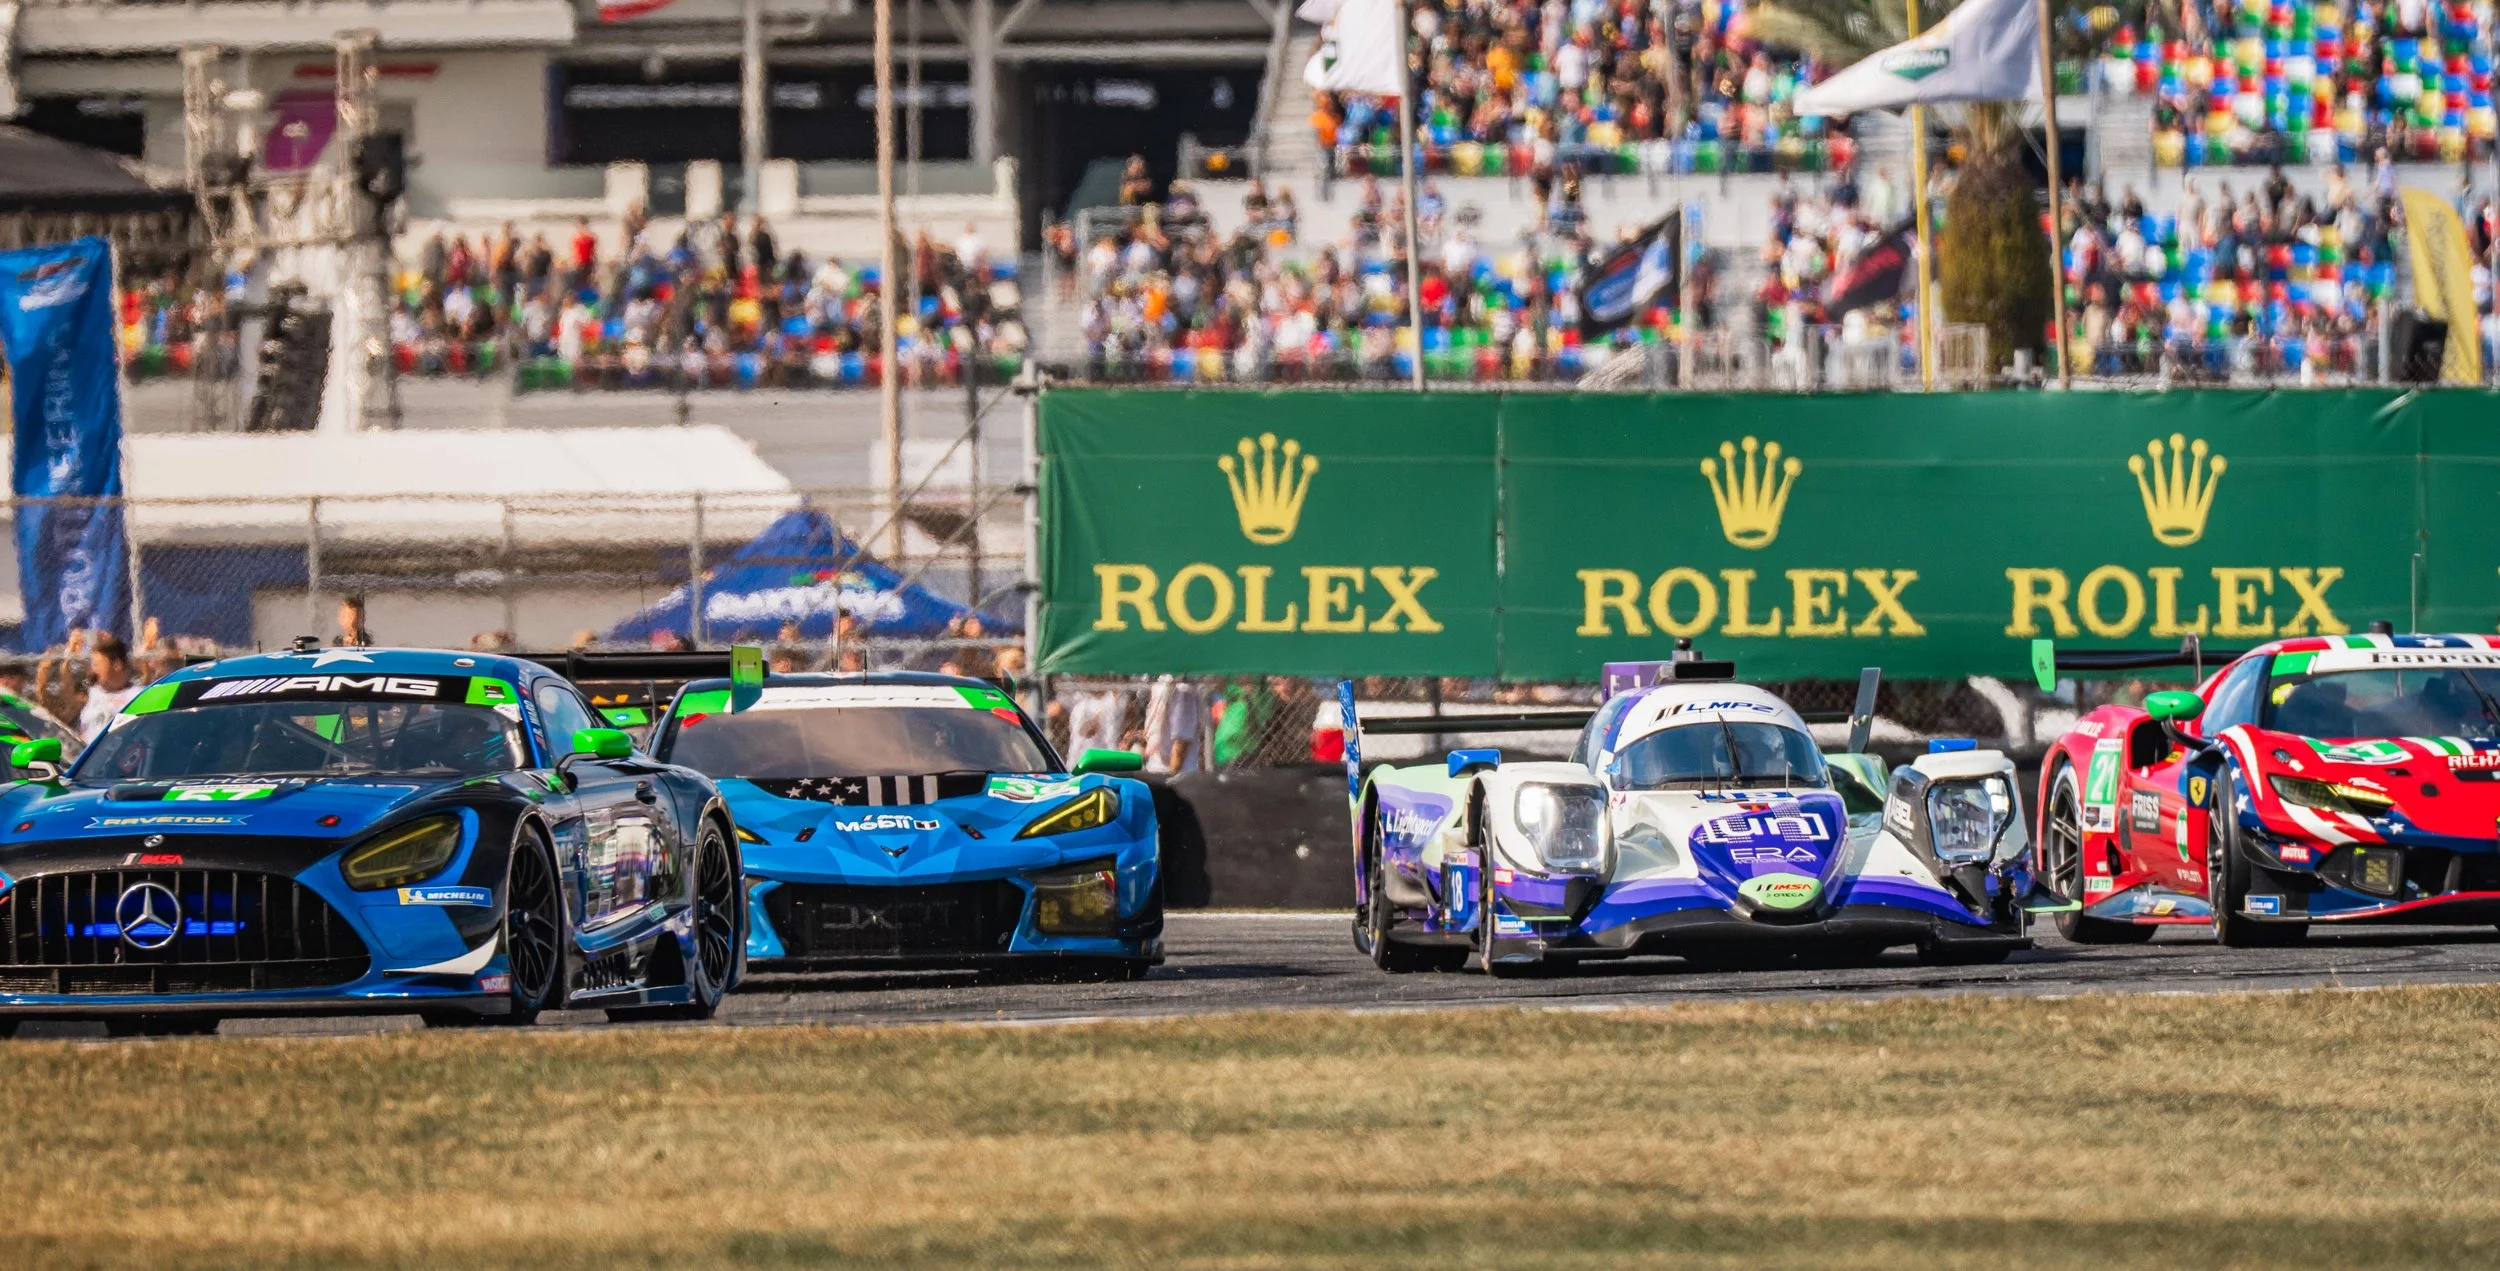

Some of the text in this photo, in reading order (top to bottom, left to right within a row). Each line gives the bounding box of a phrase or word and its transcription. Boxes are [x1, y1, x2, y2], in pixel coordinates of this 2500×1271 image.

[1093, 563, 1443, 633] ROLEX
[1577, 567, 1926, 638] ROLEX
[2005, 565, 2349, 638] ROLEX
[261, 676, 440, 696] AMG
[1687, 701, 1774, 713] LMP2
[2091, 753, 2116, 802] 21
[2132, 794, 2160, 820] FRISS
[103, 816, 232, 826] RAVENOL
[835, 814, 913, 832] Mobil
[1730, 846, 1817, 860] ERA
[427, 891, 485, 901] MICHELIN
[1452, 870, 1464, 912] 18
